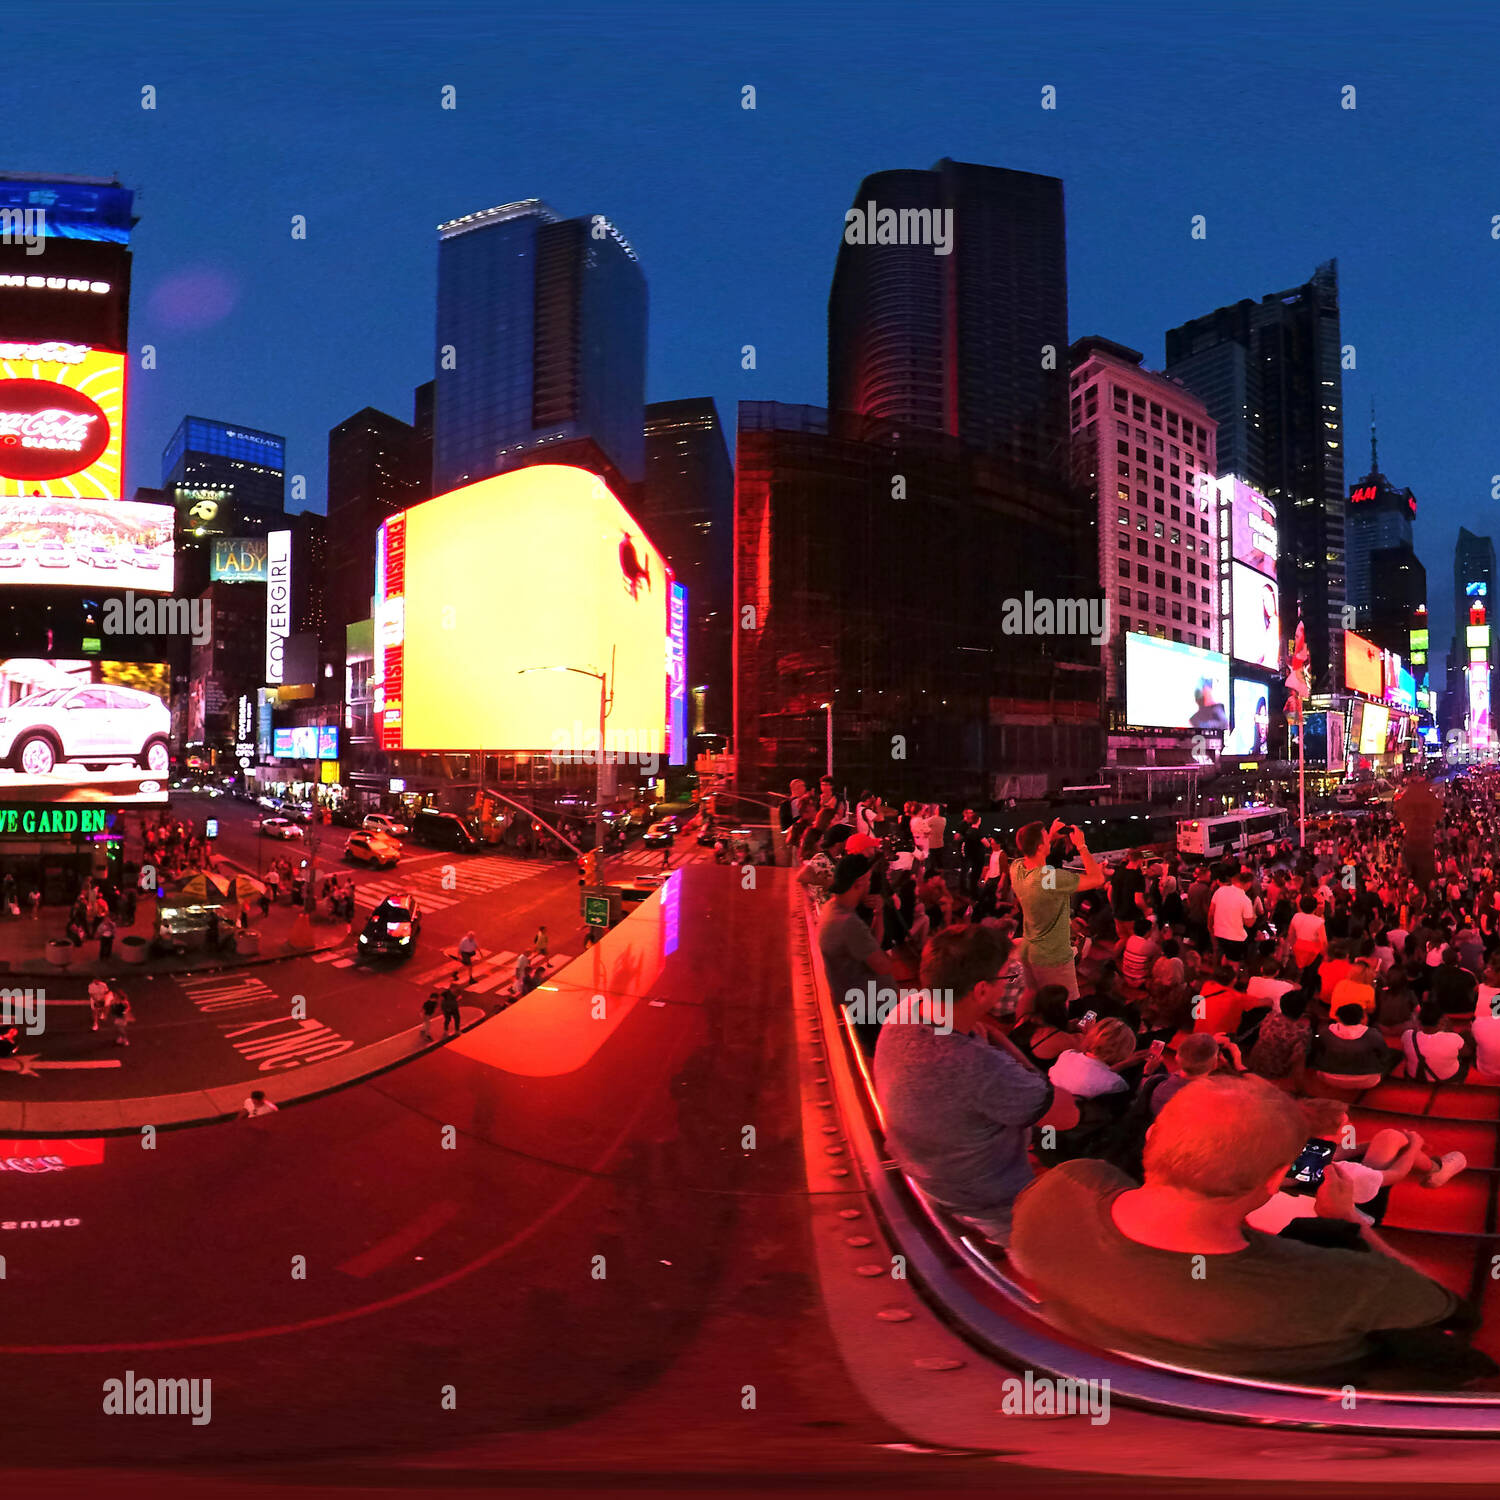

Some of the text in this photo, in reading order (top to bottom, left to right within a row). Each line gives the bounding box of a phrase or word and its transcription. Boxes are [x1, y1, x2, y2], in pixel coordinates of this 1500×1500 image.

[216, 541, 236, 552] MY
[216, 552, 267, 572] LADY
[385, 519, 405, 598] EXCLUSIVE
[270, 553, 287, 678] COVERGIRL
[384, 645, 402, 702] INSIDE
[670, 595, 685, 699] EDITION
[23, 809, 106, 833] GARDEN
